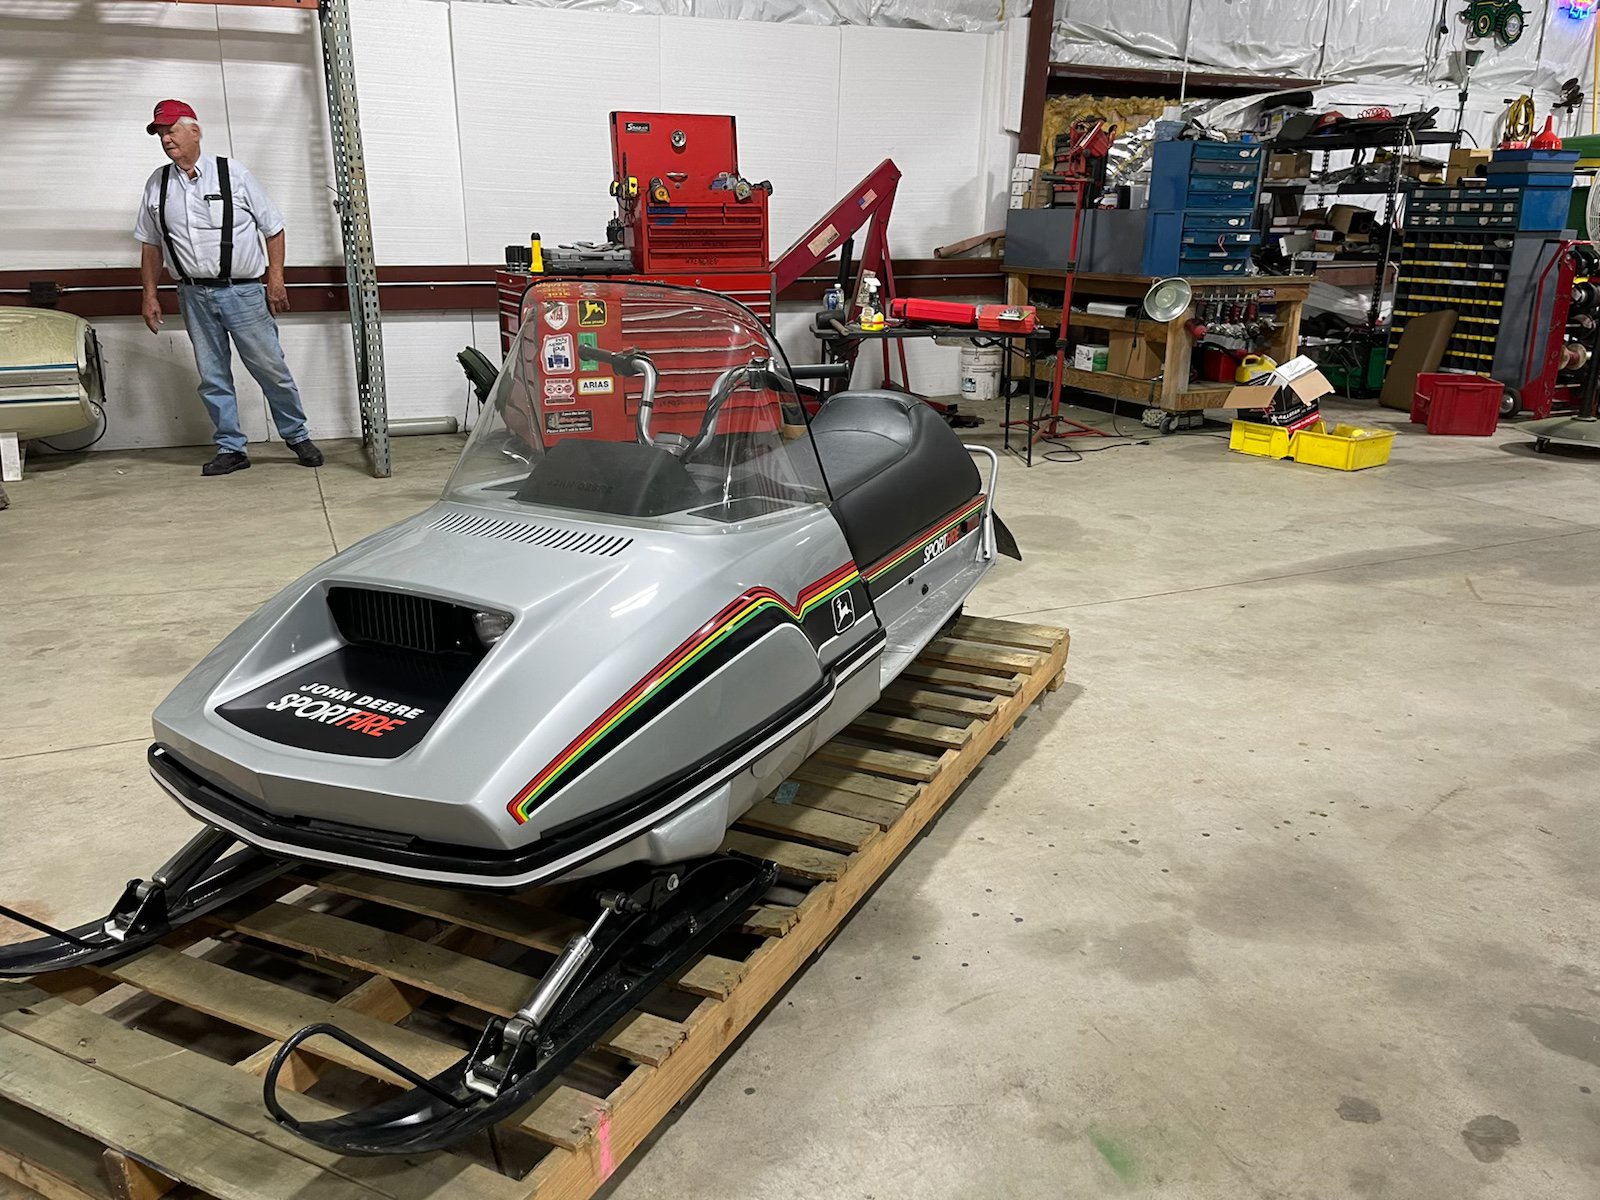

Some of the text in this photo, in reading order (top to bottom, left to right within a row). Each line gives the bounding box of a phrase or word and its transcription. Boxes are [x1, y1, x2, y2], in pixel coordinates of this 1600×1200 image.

[923, 525, 961, 563] SPORTFIRE
[266, 693, 407, 737] SPORTFIRE
[300, 682, 425, 719] JOHN DEERE
